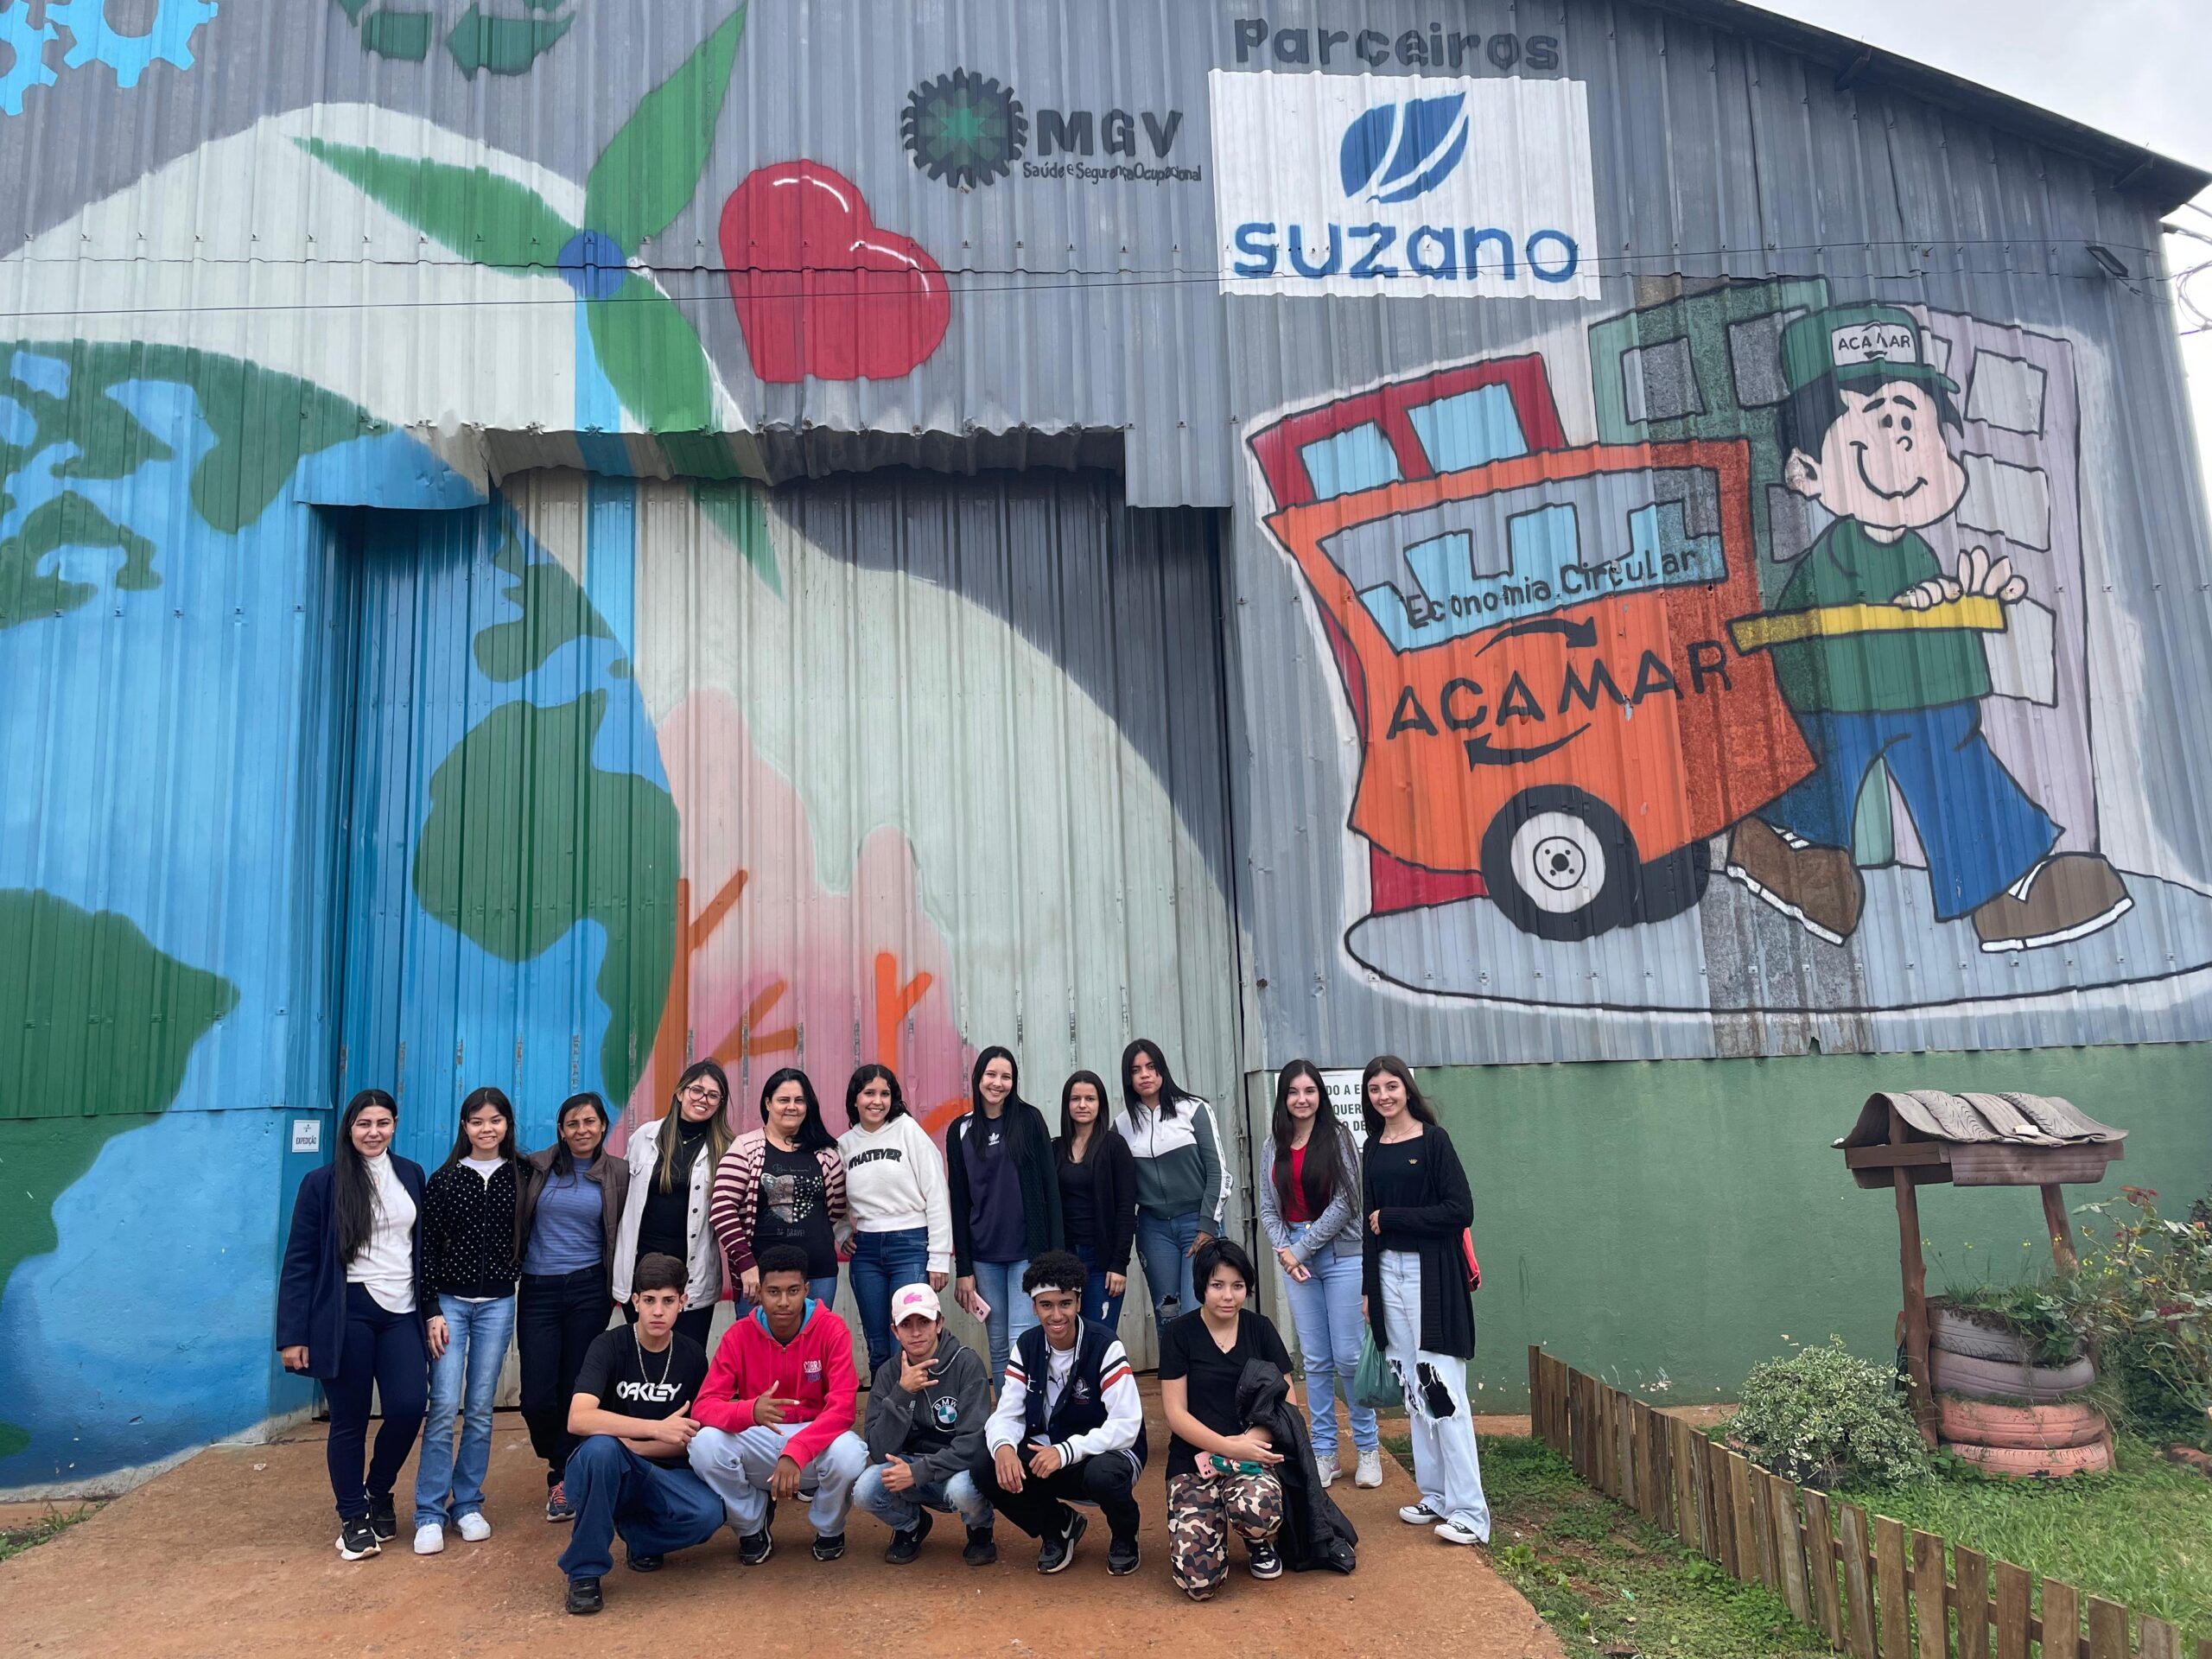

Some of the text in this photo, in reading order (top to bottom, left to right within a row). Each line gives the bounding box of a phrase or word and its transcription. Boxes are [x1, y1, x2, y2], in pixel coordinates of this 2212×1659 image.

[1234, 17, 1560, 71] Parceiros
[1036, 109, 1183, 158] MGV
[1022, 161, 1065, 179] Saúde
[1234, 221, 1578, 283] suzano
[1407, 550, 1696, 630] Economia Circular
[1385, 639, 1732, 740] ACAMAR
[1344, 1084, 1351, 1096] A
[296, 1135, 317, 1146] EXPEDIÇÃO
[615, 1380, 683, 1402] OAKLEY
[934, 1398, 957, 1410] BMW
